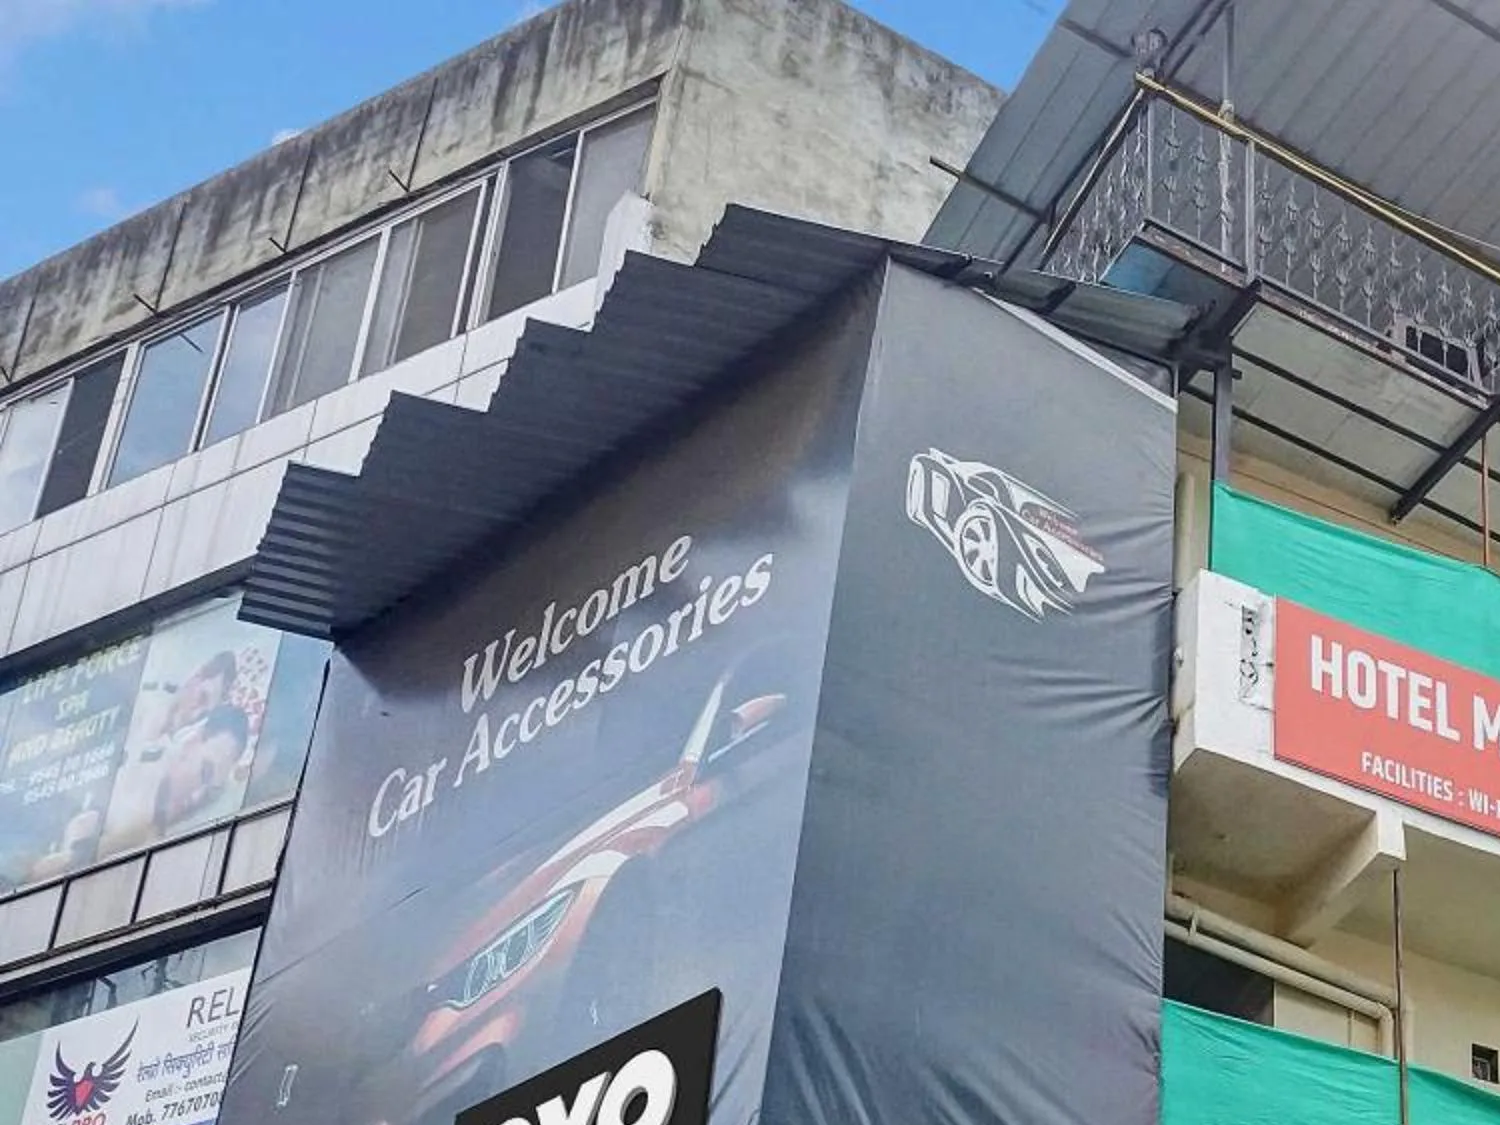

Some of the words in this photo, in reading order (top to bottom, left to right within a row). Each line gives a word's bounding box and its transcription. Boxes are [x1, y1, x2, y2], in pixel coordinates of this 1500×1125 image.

[461, 535, 693, 713] Welcome
[368, 758, 447, 837] Car
[454, 553, 774, 788] Accessories
[1311, 634, 1460, 742] HOTEL
[1361, 752, 1453, 800] FACILITIES
[161, 1091, 220, 1120] 7767070
